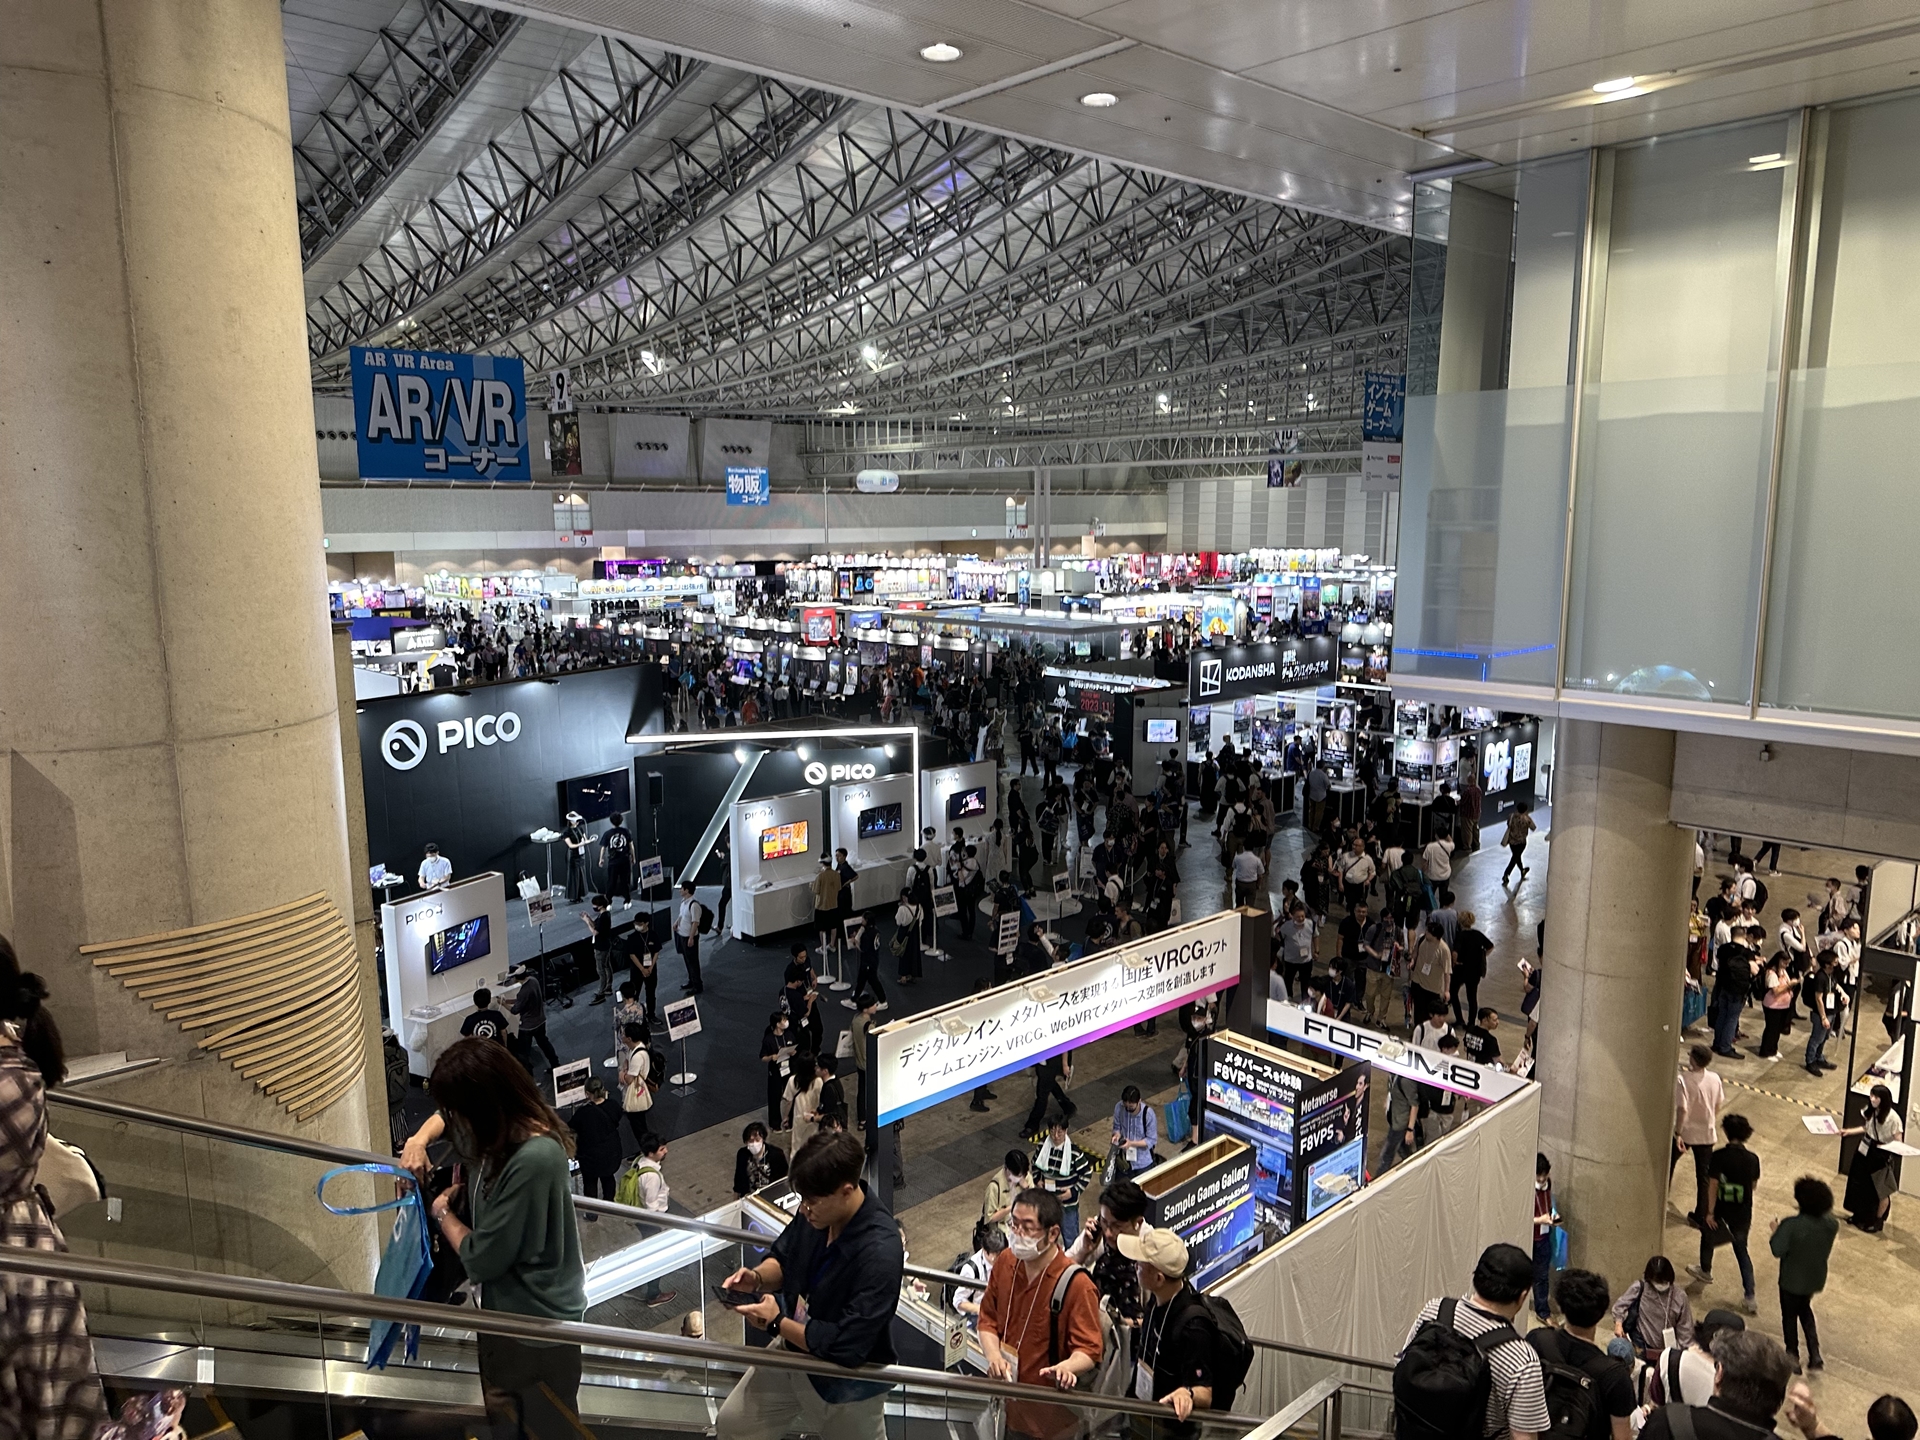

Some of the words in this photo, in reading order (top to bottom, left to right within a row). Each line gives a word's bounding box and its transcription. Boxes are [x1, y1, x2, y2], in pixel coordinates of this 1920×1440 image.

[419, 356, 455, 371] Area
[555, 372, 565, 400] 9
[1367, 383, 1404, 402] インディー
[367, 373, 517, 445] AR/VR
[1366, 401, 1392, 418] ゲーム
[1366, 419, 1392, 431] コーナー
[423, 447, 519, 473] コーナー
[728, 474, 760, 494] 物販
[741, 495, 767, 504] コーナー
[580, 535, 587, 547] 9
[1019, 529, 1027, 538] 10
[582, 584, 626, 596] CAPCOM
[1225, 661, 1276, 682] KODANSHA
[437, 711, 522, 754] PICO
[831, 763, 876, 781] PICO
[405, 908, 434, 926] PICO
[1213, 1061, 1255, 1090] F8VPS
[1224, 1051, 1302, 1092] メタバースを体験
[1300, 1087, 1338, 1116] Metaverse
[1300, 1123, 1334, 1156] F8VPS
[1163, 1193, 1196, 1222] Sample
[1197, 1179, 1220, 1203] Game
[1221, 1163, 1250, 1190] Gallery
